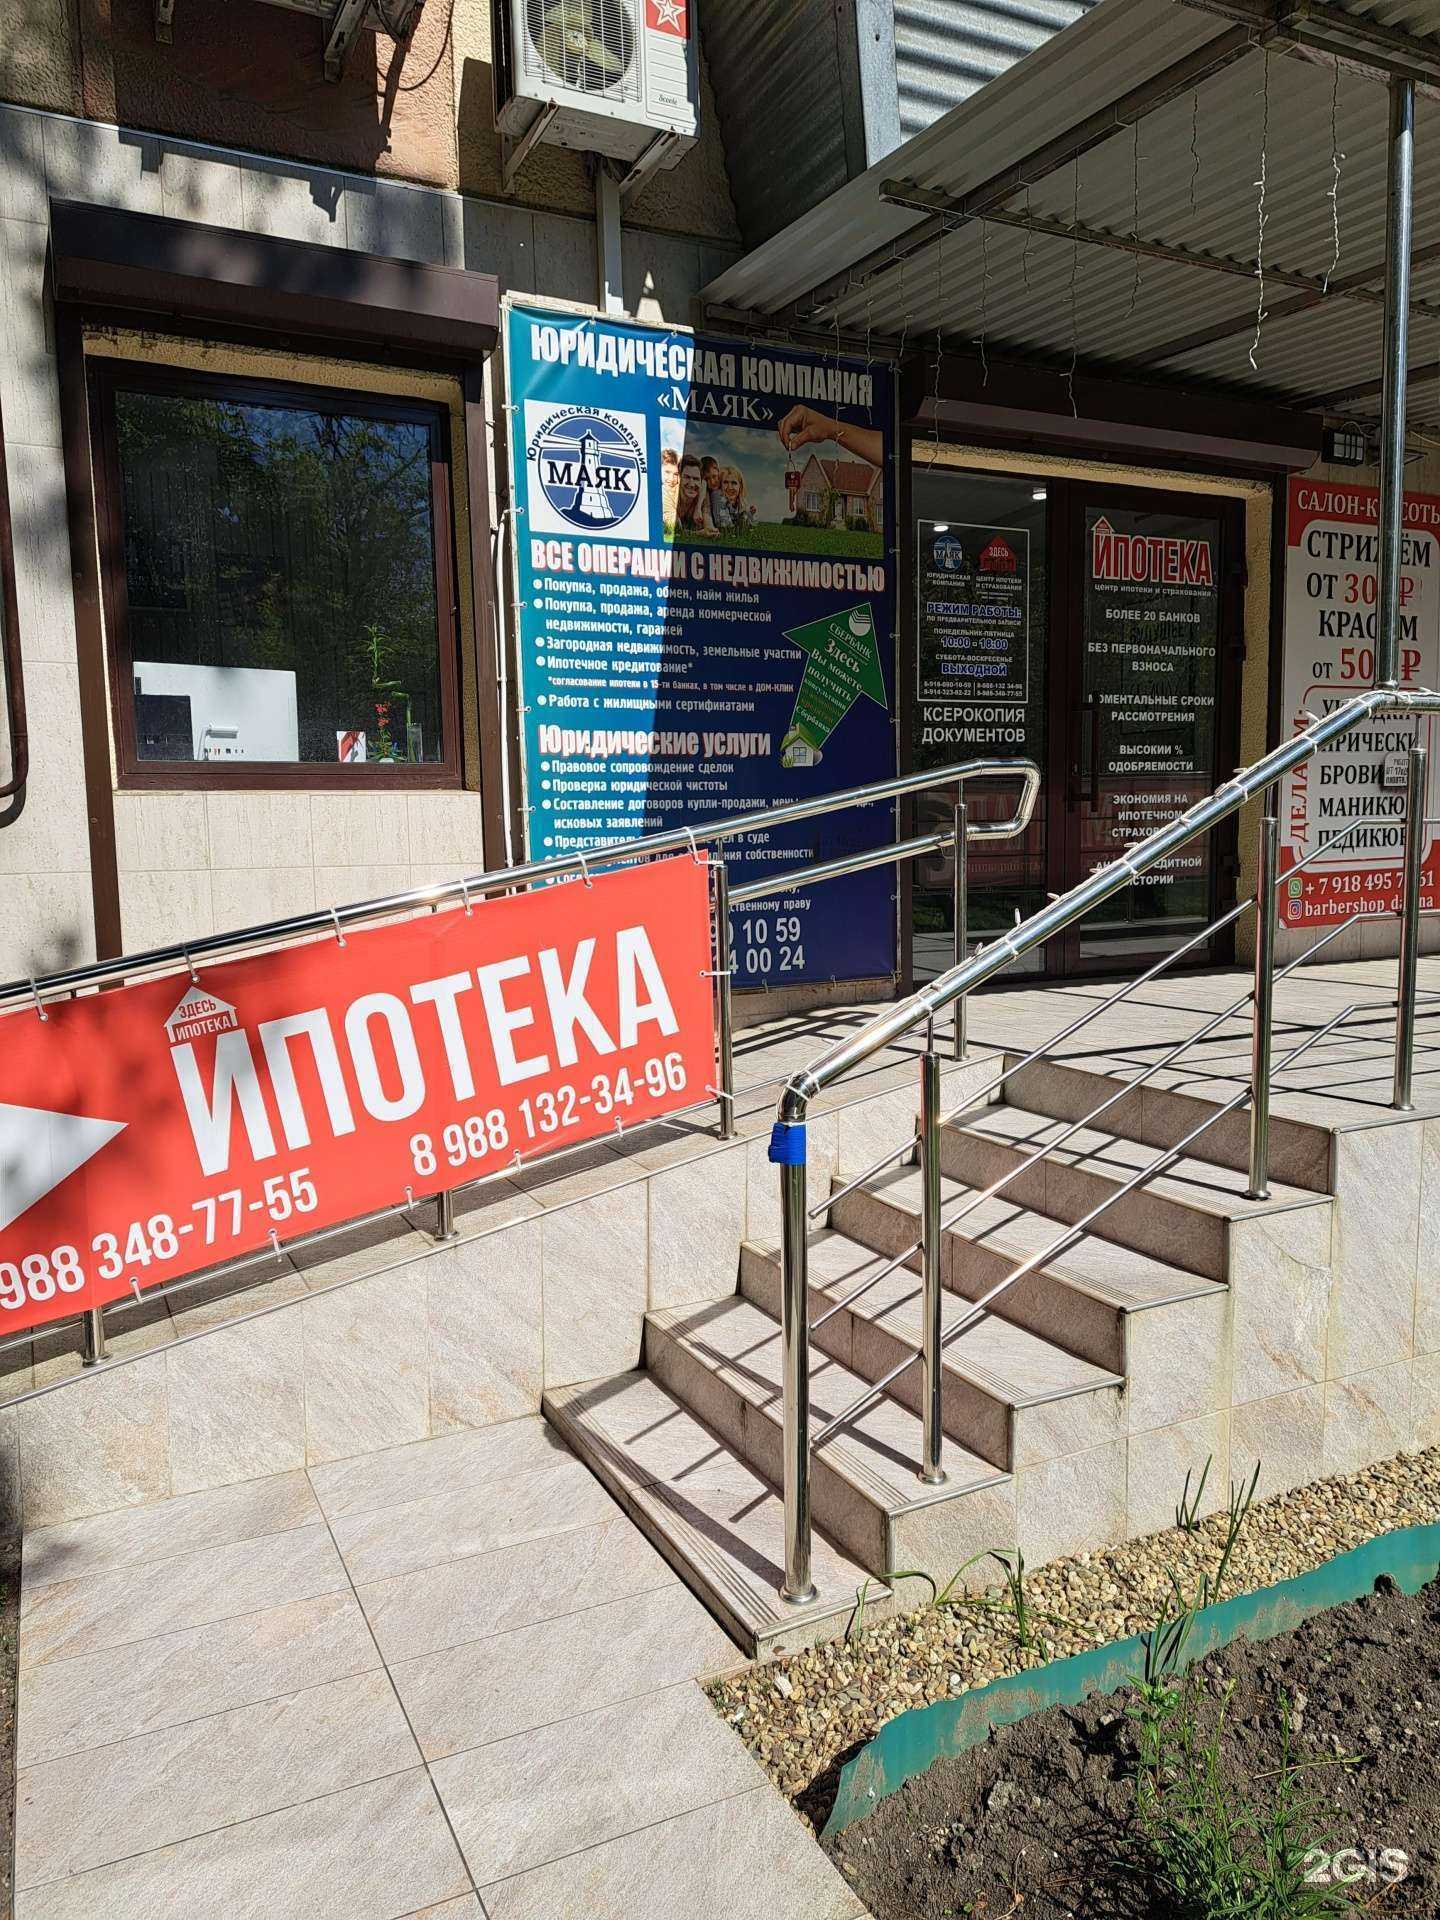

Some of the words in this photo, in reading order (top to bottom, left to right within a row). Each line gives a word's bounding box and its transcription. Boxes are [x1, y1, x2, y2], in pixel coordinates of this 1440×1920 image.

[531, 324, 735, 387] ЮРИДИЧЕСКАЯ
[741, 356, 873, 407] КОМПАНИЯ
[657, 386, 774, 421] «МАЯК»
[527, 406, 600, 461] Юридическая
[603, 413, 647, 474] компания
[547, 461, 632, 491] МАЯК
[988, 546, 1009, 557] ЗДЕСЬ
[1307, 529, 1431, 568] СТРИЁМ
[531, 539, 574, 572] ВСЕ
[577, 543, 687, 582] ОПЕРАЦИИ
[690, 552, 704, 580] С
[708, 553, 885, 592] НЕДВИЖИМОСТЬЮ
[1093, 533, 1213, 586] ИПОТЕКА
[544, 578, 596, 595] Покупка,
[600, 583, 652, 598] продажа,
[656, 586, 693, 601] обмен,
[696, 588, 722, 601] найм
[725, 591, 760, 604] жилья
[1094, 583, 1119, 592] центр
[1121, 585, 1153, 594] ипотеки
[1162, 587, 1212, 597] страхования
[1306, 572, 1338, 599] ОТ
[545, 597, 597, 614] Покупка,
[600, 602, 653, 617] продажа,
[656, 605, 694, 618] аренда
[698, 607, 772, 622] коммерческой
[926, 602, 970, 615] РЕЖИМ
[971, 604, 1022, 618] РАБОТЫ:
[1105, 608, 1141, 621] БОЛЕЕ
[1144, 610, 1157, 621] 20
[1159, 611, 1201, 623] БАНКОВ
[546, 618, 632, 635] недвижимости,
[636, 622, 683, 636] гаражей
[933, 628, 1015, 638] ПОНЕДЕЛЬНИК-ПЯТНИЦА
[1319, 609, 1418, 641] КРАСМ
[546, 636, 613, 653] Загородная
[617, 641, 699, 656] недвижимость,
[703, 645, 760, 658] земельные
[764, 648, 802, 660] участки
[829, 622, 873, 659] СБЕРБАНК
[940, 636, 971, 649] 10:00
[979, 638, 1009, 650] 18:00
[1087, 642, 1109, 653] БЕЗ
[1111, 643, 1216, 657] ПЕРВОНАЧАЛЬНОГО
[547, 655, 608, 670] Ипотечное
[824, 637, 861, 673] Здесь
[935, 653, 1013, 663] СУББОТА-ВОСКРЕСЕНЬЕ
[810, 648, 828, 666] Вы
[827, 662, 863, 692] можете
[941, 663, 1008, 677] ВЫХОДНОЙ
[1132, 661, 1174, 672] ВЗНОСА
[609, 679, 641, 688] ипотеки
[672, 681, 701, 690] банках,
[710, 682, 723, 690] том
[725, 683, 746, 692] числе
[806, 665, 853, 702] получить
[548, 694, 590, 708] Работа
[594, 698, 600, 708] с
[603, 698, 672, 711] жилищными
[675, 699, 755, 712] сертификатами
[1180, 696, 1215, 706] СРОКИ
[923, 706, 1025, 722] КСЕРОКОПИЯ
[1111, 711, 1195, 722] РАССМОТРЕНИЯ
[539, 724, 699, 759] Юридические
[703, 732, 771, 758] услуги
[922, 727, 1026, 744] ДОКУМЕНТОВ
[1174, 744, 1184, 755] %
[552, 760, 606, 774] Правовое
[610, 762, 694, 775] сопровождение
[698, 763, 734, 774] сделок
[1108, 760, 1194, 773] ОДОБРЯЕМОСТИ
[1320, 764, 1384, 785] БРОВИ
[552, 779, 607, 793] Проверка
[611, 779, 683, 793] юридической
[686, 780, 728, 791] чистоты
[553, 797, 624, 810] Составление
[628, 800, 684, 811] договоров
[687, 798, 769, 812] купли-продажи,
[1112, 794, 1172, 805] ЭКОНОМИЯ
[1174, 794, 1189, 804] НА
[1319, 796, 1406, 818] МАНИКЮ
[554, 818, 602, 829] исковых
[606, 816, 663, 828] заявлений
[1118, 811, 1183, 821] ИПОТЕЧНОМ
[737, 834, 744, 843] в
[747, 833, 770, 845] суде
[745, 848, 815, 860] собственности
[1153, 856, 1203, 870] ЕДИТНОЙ
[1318, 878, 1328, 895] 7
[1332, 874, 1361, 893] 918
[1364, 873, 1392, 891] 495
[783, 898, 812, 911] праву
[742, 919, 768, 944] 10
[776, 917, 801, 942] 59
[746, 948, 772, 973] 00
[779, 945, 805, 971] 24
[178, 999, 217, 1019] ЗДЕСЬ
[176, 1015, 232, 1041] ИПОТЕКА
[170, 925, 681, 1178] ИПОТЕКА
[410, 1133, 437, 1177] 8
[443, 1109, 510, 1167] 988
[519, 1052, 687, 1139] 132-34-96
[0, 1245, 86, 1310] 988
[92, 1168, 319, 1280] 348-77-55
